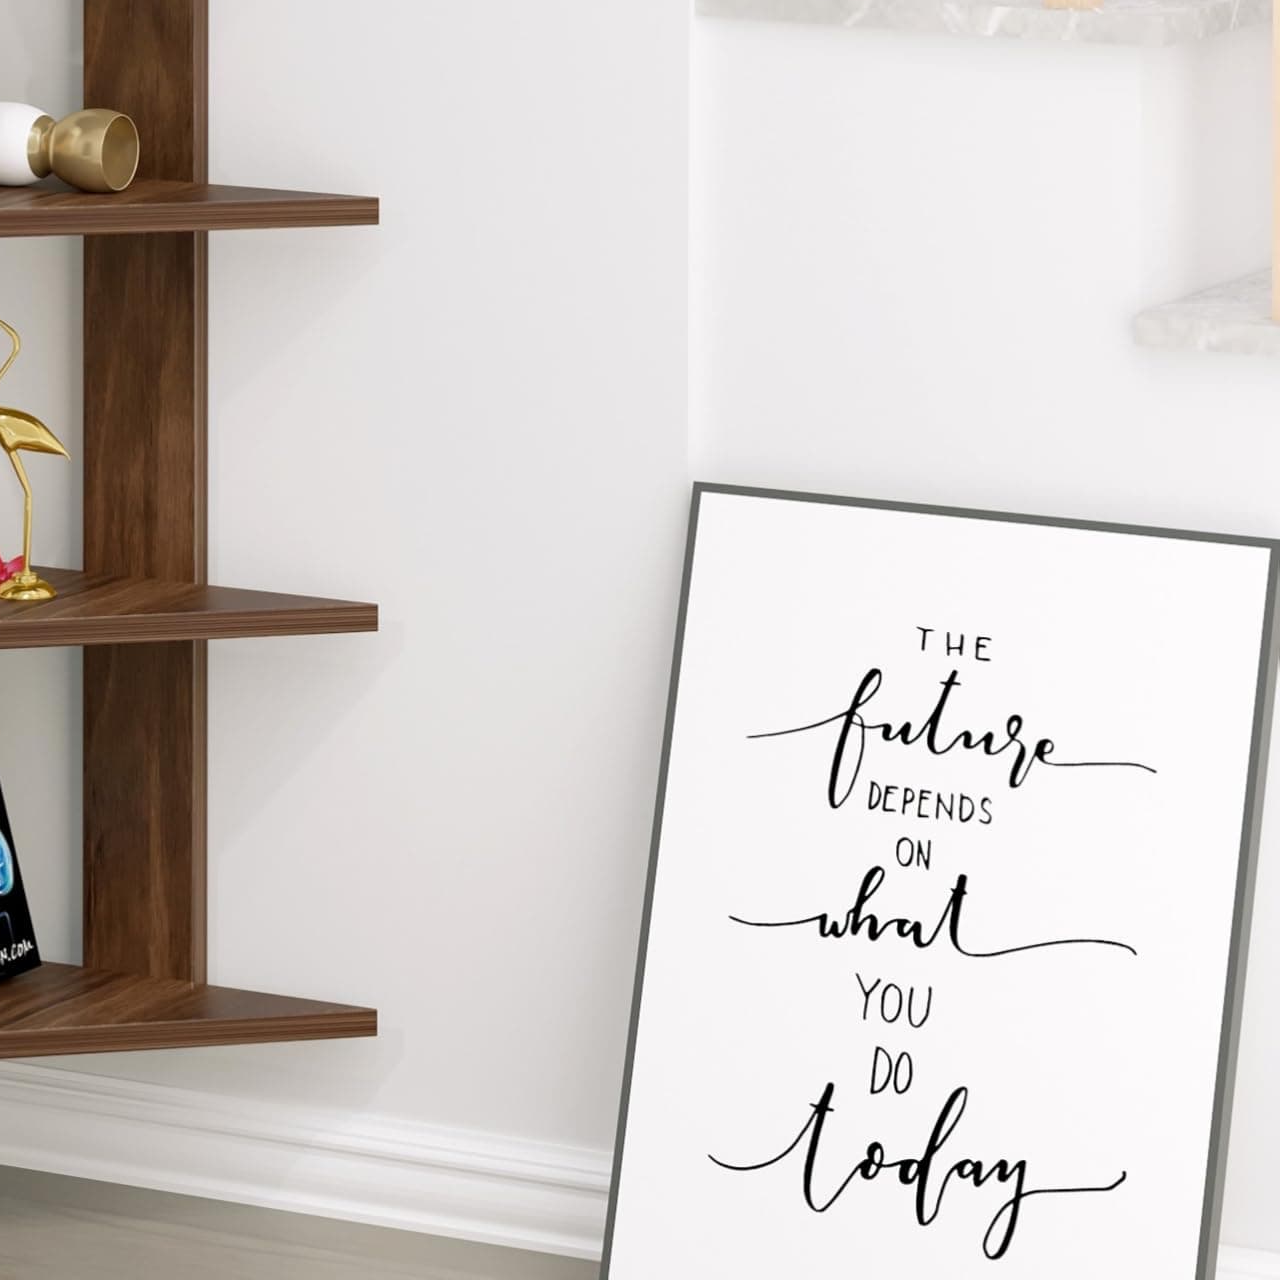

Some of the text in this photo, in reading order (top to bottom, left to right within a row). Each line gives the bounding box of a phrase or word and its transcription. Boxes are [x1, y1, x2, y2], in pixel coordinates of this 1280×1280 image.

[916, 626, 992, 662] THE
[747, 667, 1157, 810] future
[867, 780, 992, 825] DEPENDS
[895, 836, 932, 871] ON
[728, 865, 1138, 958] what
[855, 973, 933, 1029] YOU
[869, 1046, 913, 1095] DO
[707, 1082, 1127, 1261] today
